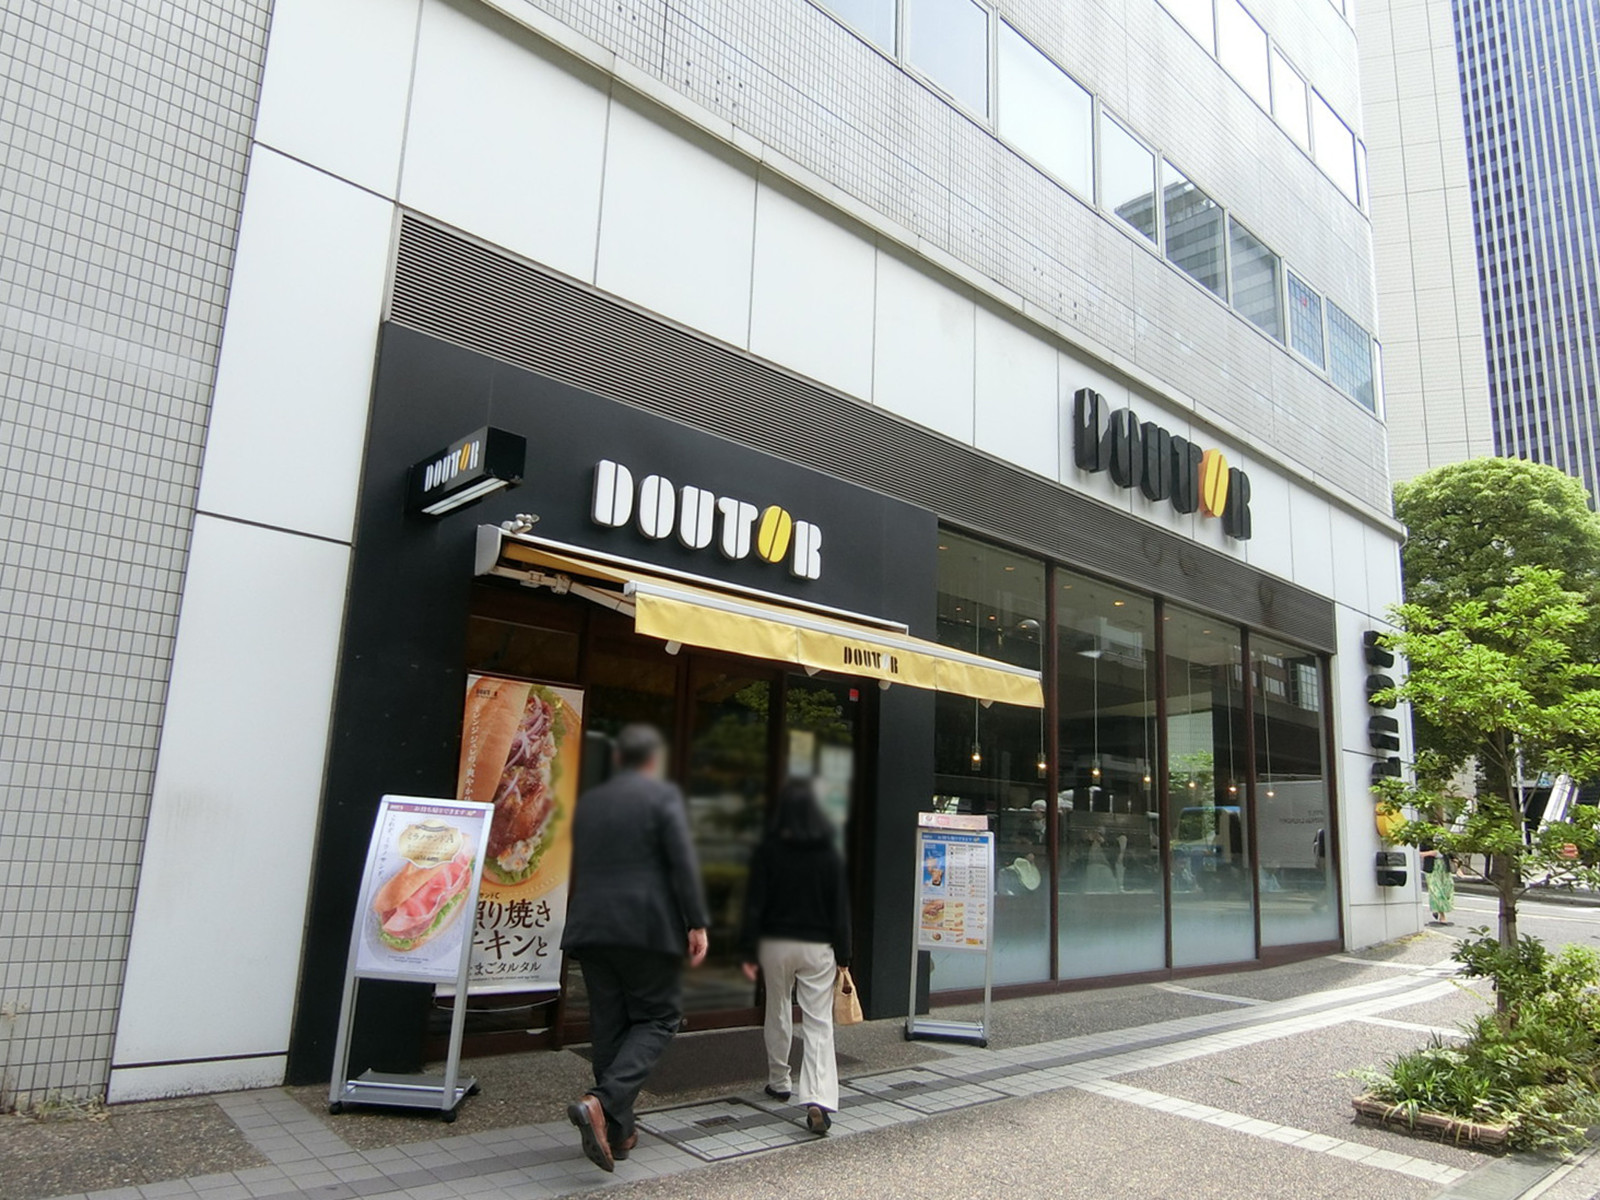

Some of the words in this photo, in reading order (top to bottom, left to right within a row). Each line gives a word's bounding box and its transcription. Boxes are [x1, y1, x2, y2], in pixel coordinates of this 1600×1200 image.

[424, 440, 480, 493] DOUTOR
[1074, 387, 1252, 541] DOUTOR
[591, 458, 823, 581] DOUTOR
[844, 646, 899, 674] DOUTOR
[469, 960, 542, 976] まごタルタル
